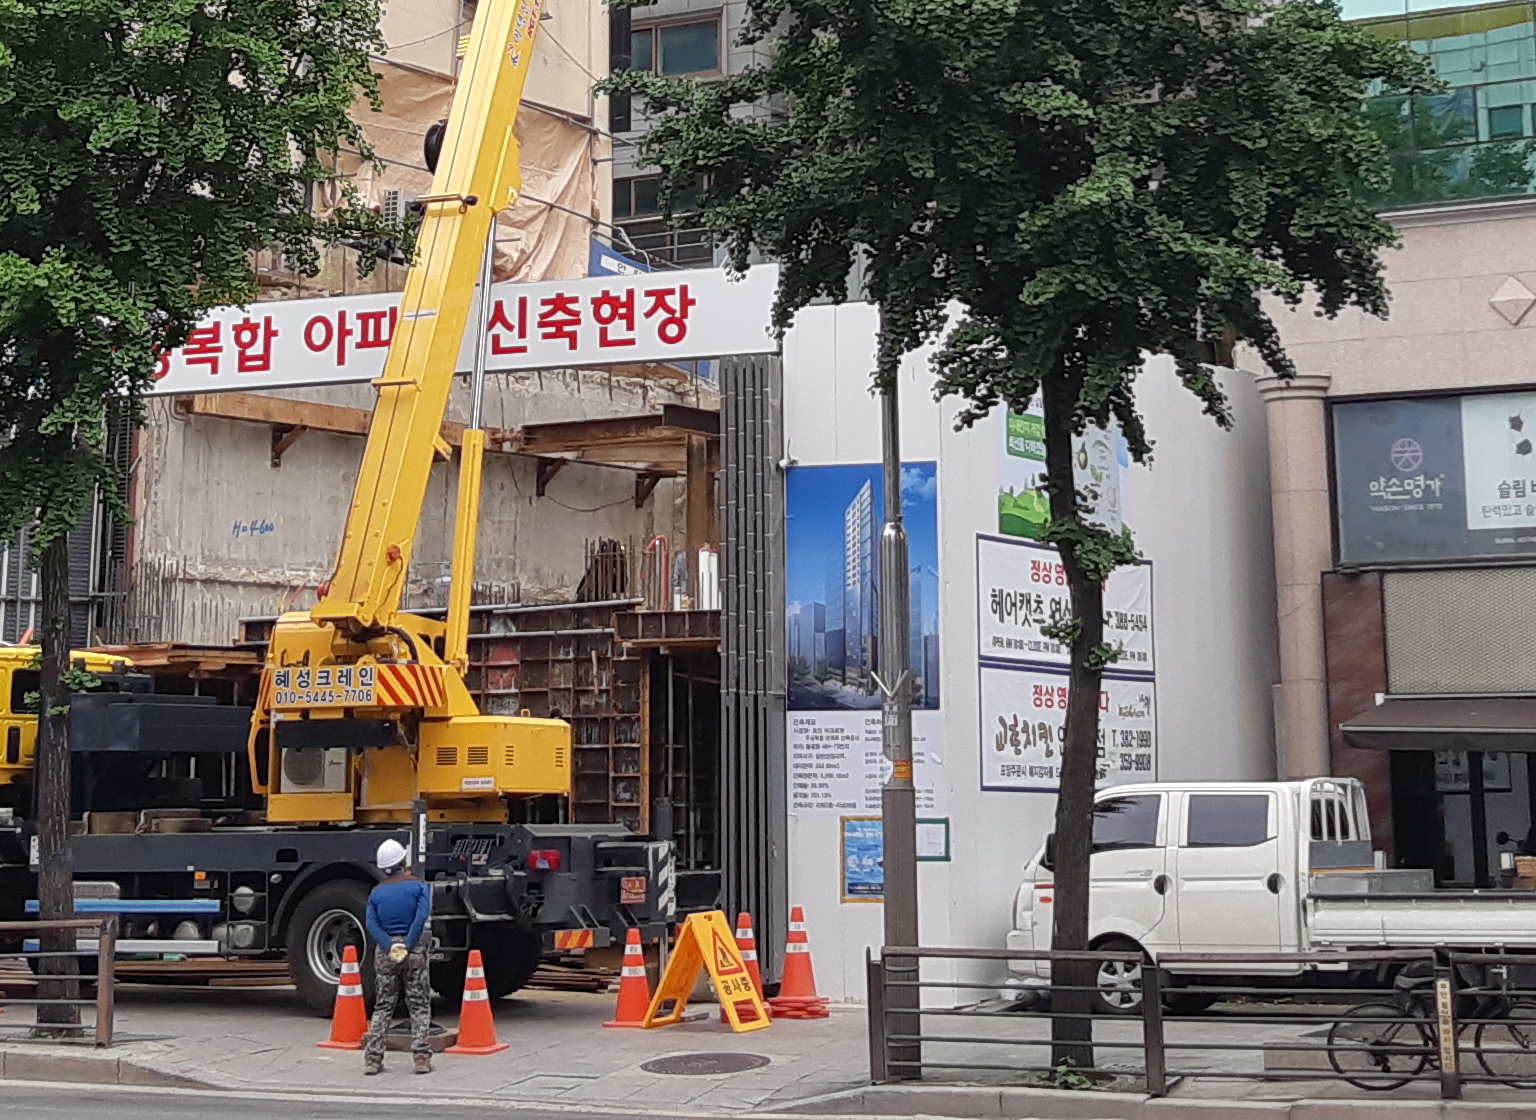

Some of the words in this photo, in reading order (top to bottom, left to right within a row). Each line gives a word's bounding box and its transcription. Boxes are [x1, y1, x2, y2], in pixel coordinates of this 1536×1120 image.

[303, 304, 400, 367] 아파
[488, 283, 697, 356] 신축현장
[1368, 473, 1443, 500] 약손명가
[1497, 479, 1527, 499] 슬림
